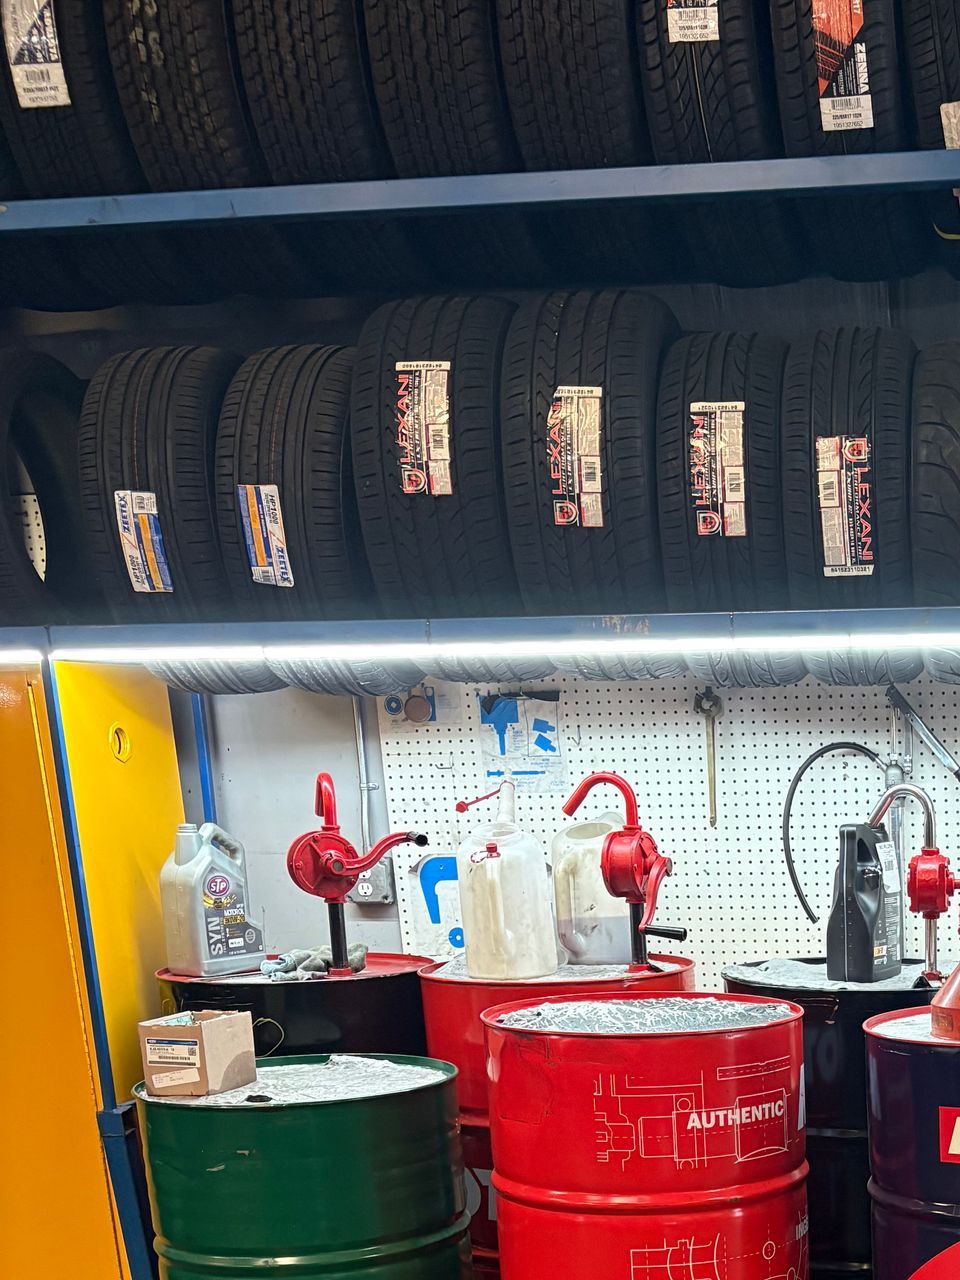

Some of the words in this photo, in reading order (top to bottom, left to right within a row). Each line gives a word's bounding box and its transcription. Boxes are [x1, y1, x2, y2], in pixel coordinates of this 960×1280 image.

[854, 42, 870, 95] ZENNA
[396, 374, 411, 463] LEXANI
[117, 494, 132, 535] ZEETEX
[268, 494, 279, 525] HP1000
[856, 467, 874, 561] LEXANI
[275, 546, 291, 582] ZEETEX
[210, 878, 227, 893] STP
[207, 916, 223, 956] SYN
[686, 1099, 785, 1130] AUTHENTIC
